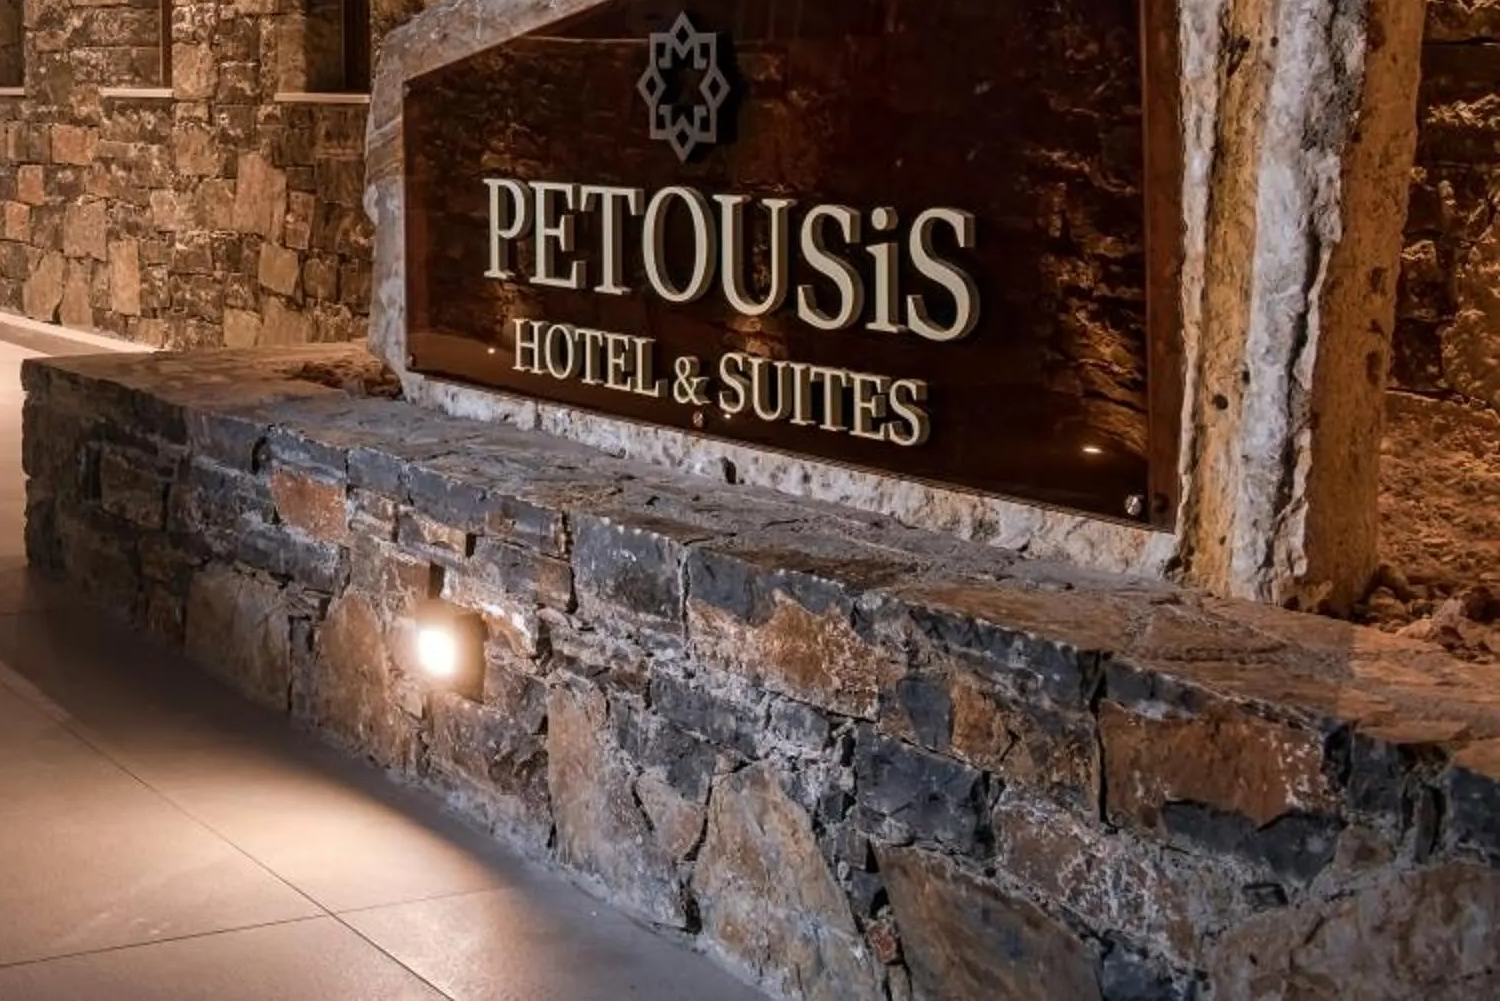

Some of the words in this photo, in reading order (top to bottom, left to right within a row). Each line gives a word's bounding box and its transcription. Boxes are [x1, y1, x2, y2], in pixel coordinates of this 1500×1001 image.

[513, 318, 666, 397] HOTEL
[673, 356, 709, 406] &
[719, 351, 931, 447] SUITES
